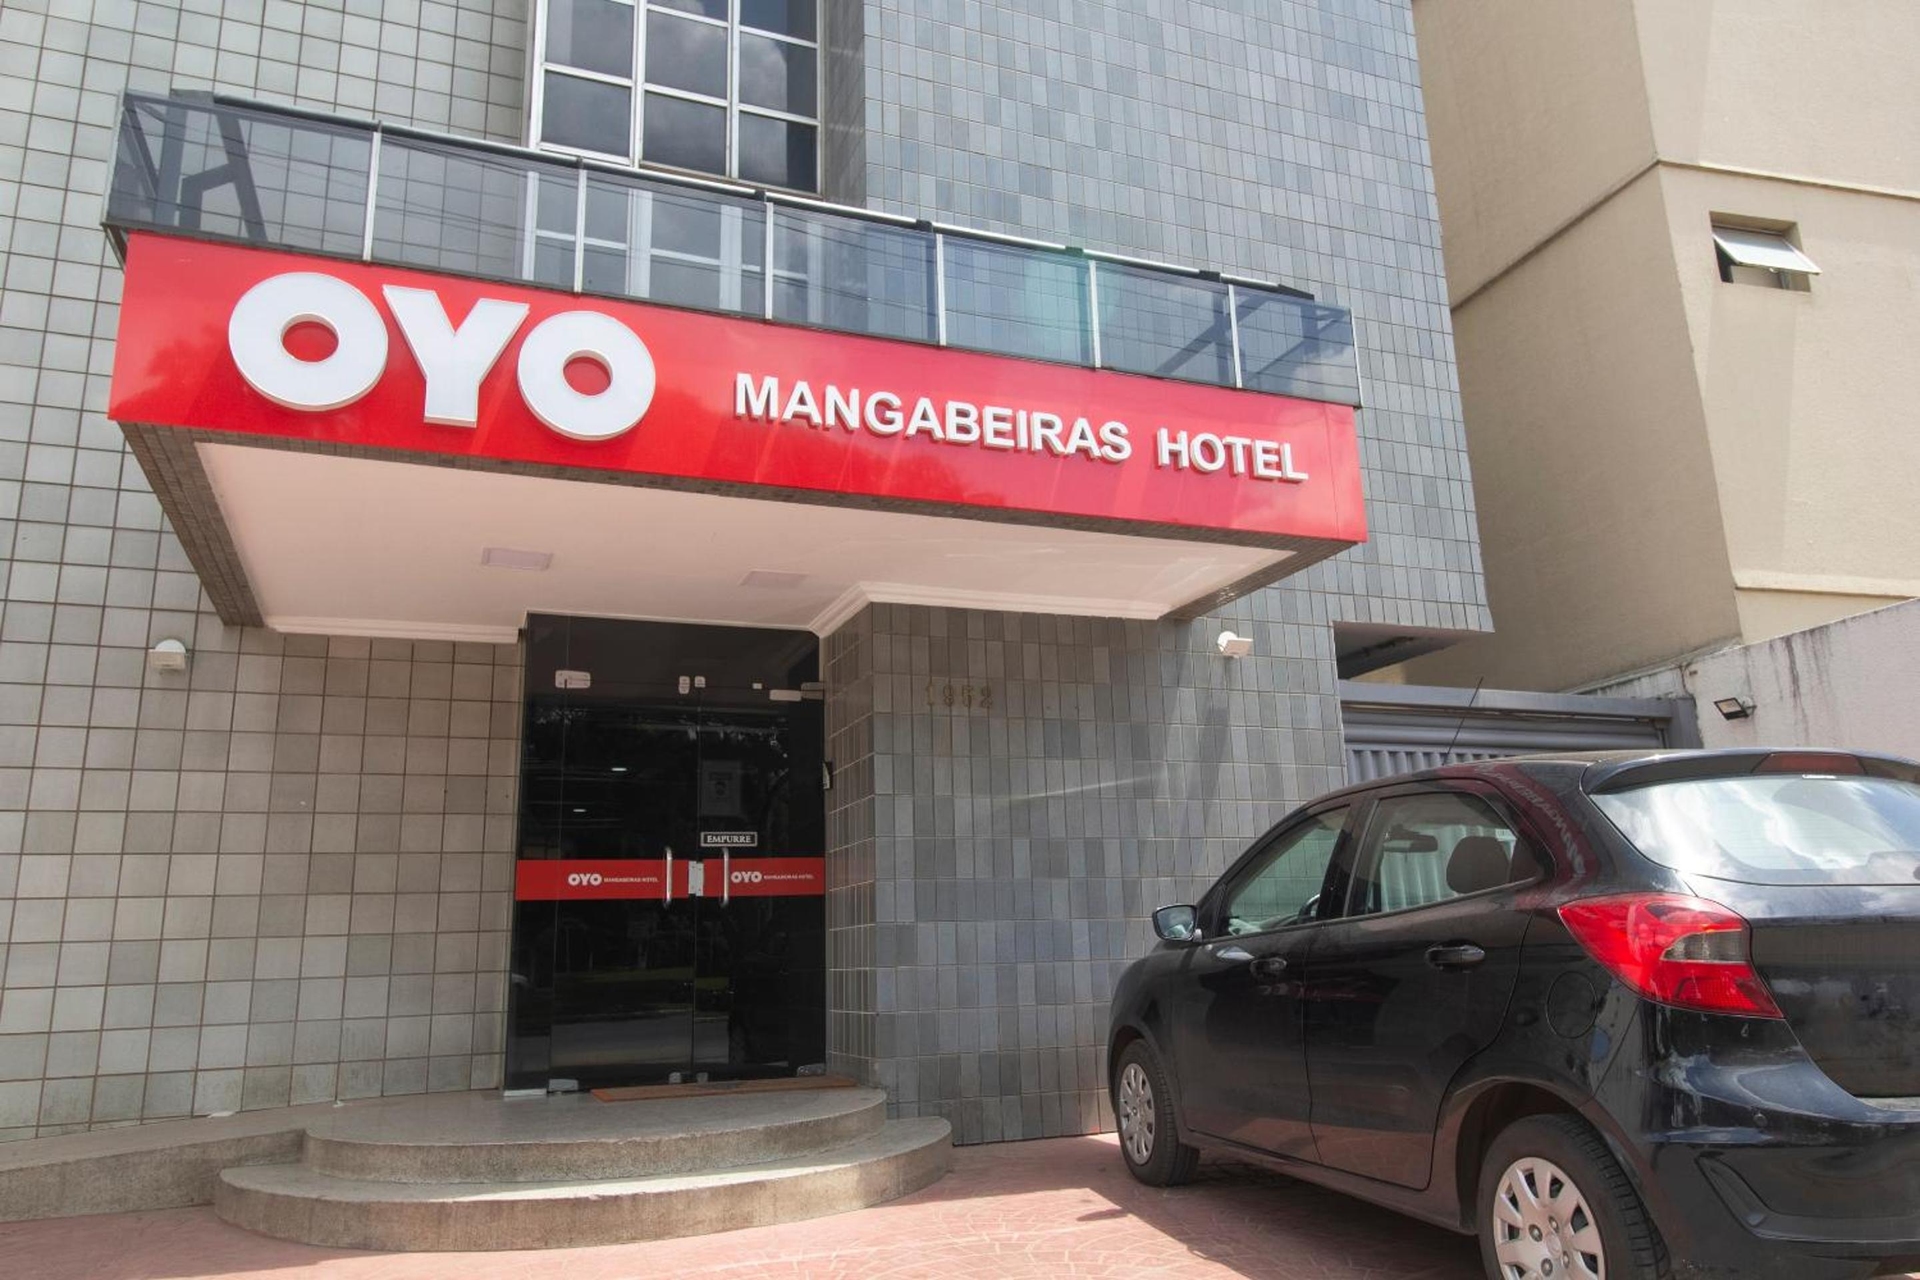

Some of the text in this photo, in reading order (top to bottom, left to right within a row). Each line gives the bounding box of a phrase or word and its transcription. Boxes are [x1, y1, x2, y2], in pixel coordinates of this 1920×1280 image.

[229, 272, 1310, 482] OYO MANGABEIRAS HOTEL
[707, 835, 753, 843] EMPURRE
[567, 873, 603, 886] OYO
[731, 871, 762, 883] OYO
